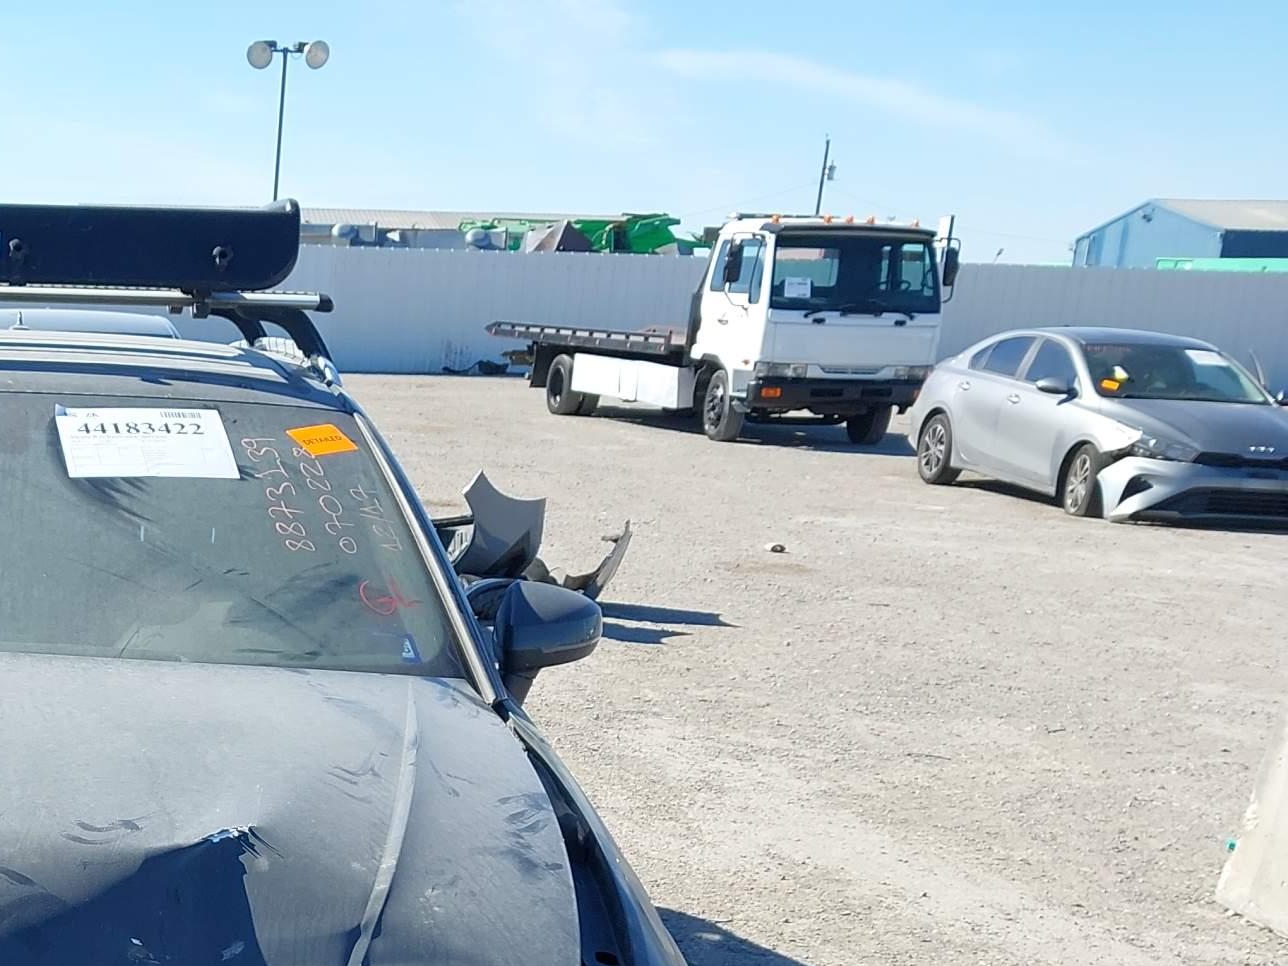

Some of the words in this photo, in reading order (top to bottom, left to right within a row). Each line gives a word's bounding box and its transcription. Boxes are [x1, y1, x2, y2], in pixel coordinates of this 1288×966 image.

[77, 422, 206, 436] 44183422
[301, 434, 343, 446] DETAILED
[240, 437, 316, 552] 8873139
